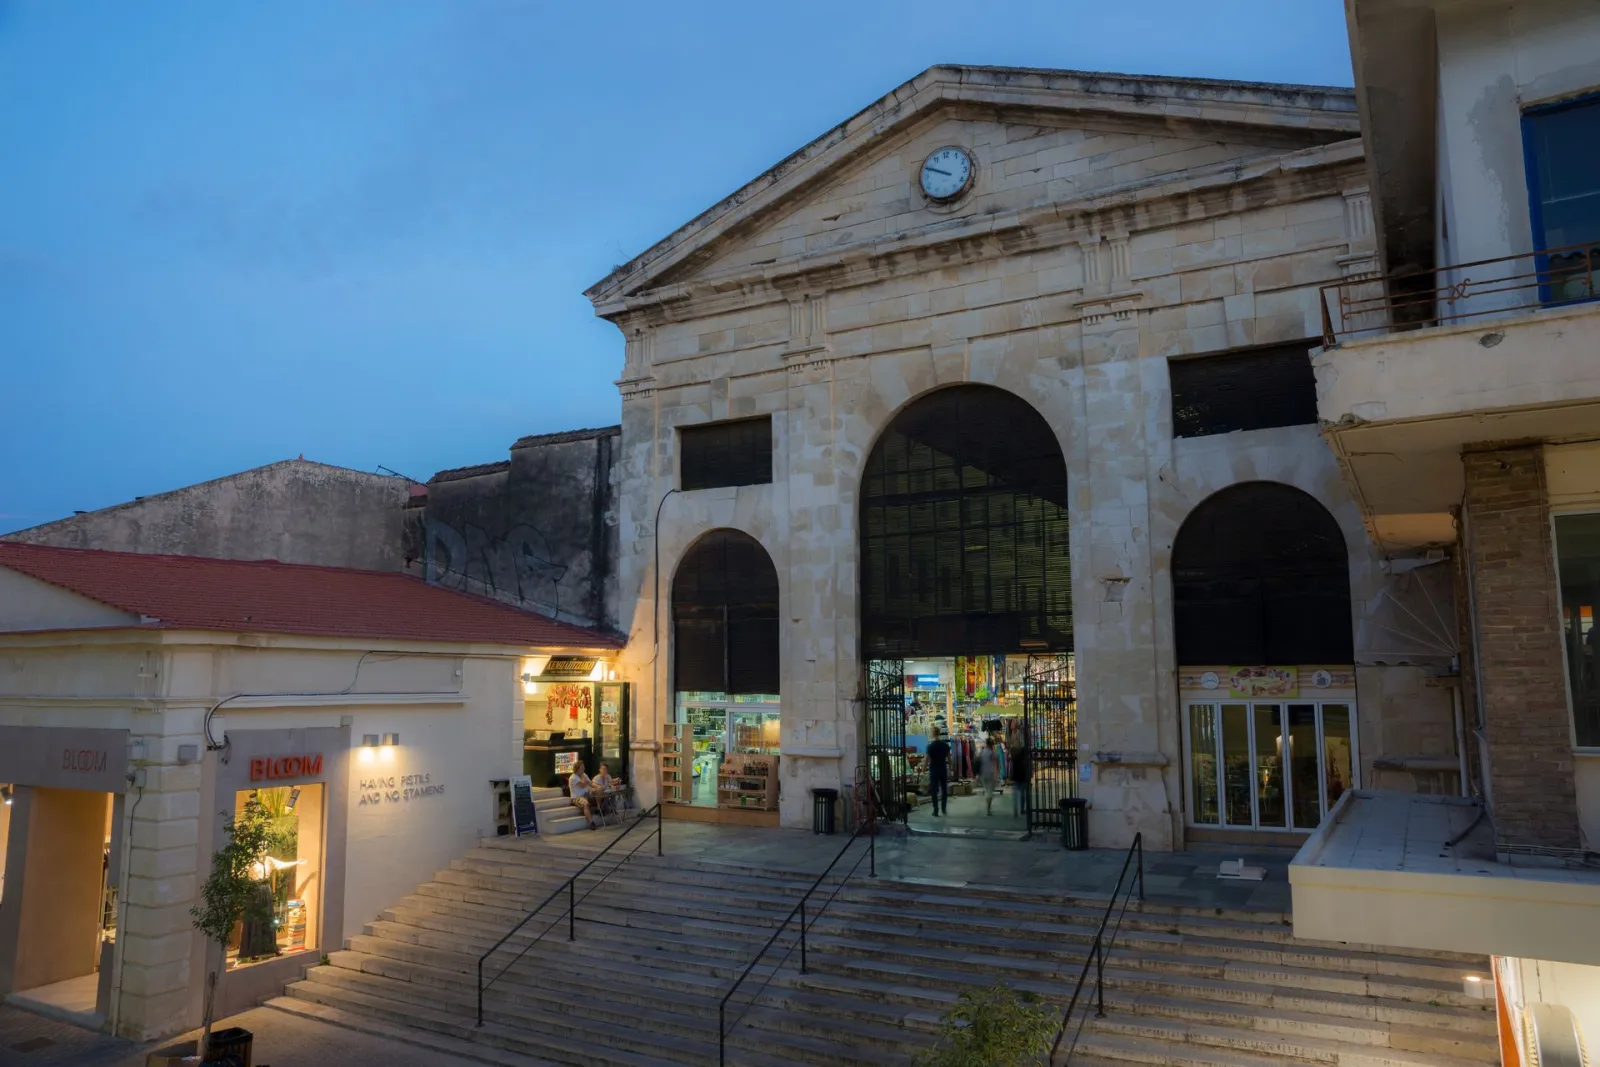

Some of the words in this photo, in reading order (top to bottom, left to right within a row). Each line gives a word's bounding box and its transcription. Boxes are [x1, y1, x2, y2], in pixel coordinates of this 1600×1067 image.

[943, 151, 950, 160] 12
[62, 748, 107, 773] BLOOM
[250, 753, 323, 781] BLOOM
[359, 776, 395, 791] HAVING
[359, 791, 381, 806] AND
[385, 790, 400, 803] NO
[403, 784, 445, 801] STAMENS
